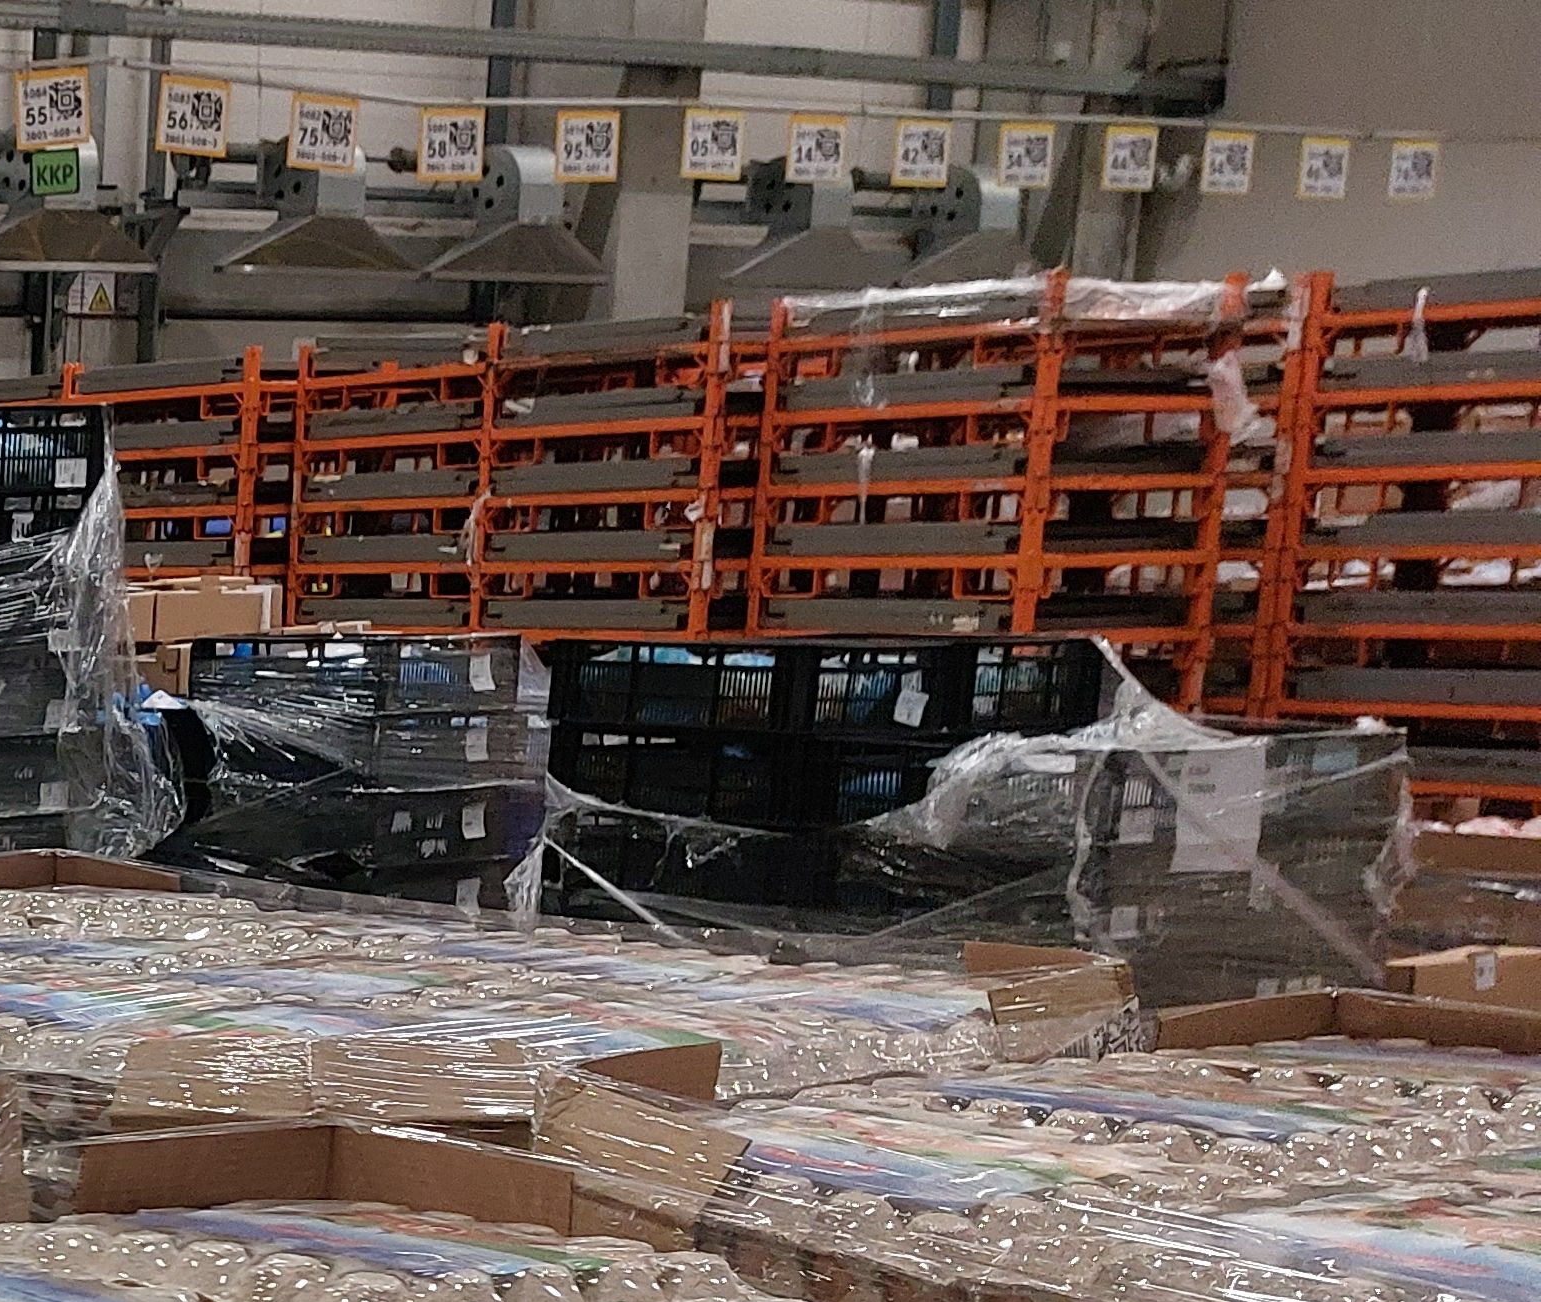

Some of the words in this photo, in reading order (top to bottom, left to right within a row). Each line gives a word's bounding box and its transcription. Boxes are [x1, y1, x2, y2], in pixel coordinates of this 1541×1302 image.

[25, 106, 48, 127] 55
[167, 111, 188, 131] 56
[298, 127, 318, 147] 75
[690, 136, 709, 157] 05
[427, 141, 447, 159] 58
[564, 141, 583, 160] 95
[36, 164, 74, 187] KKP
